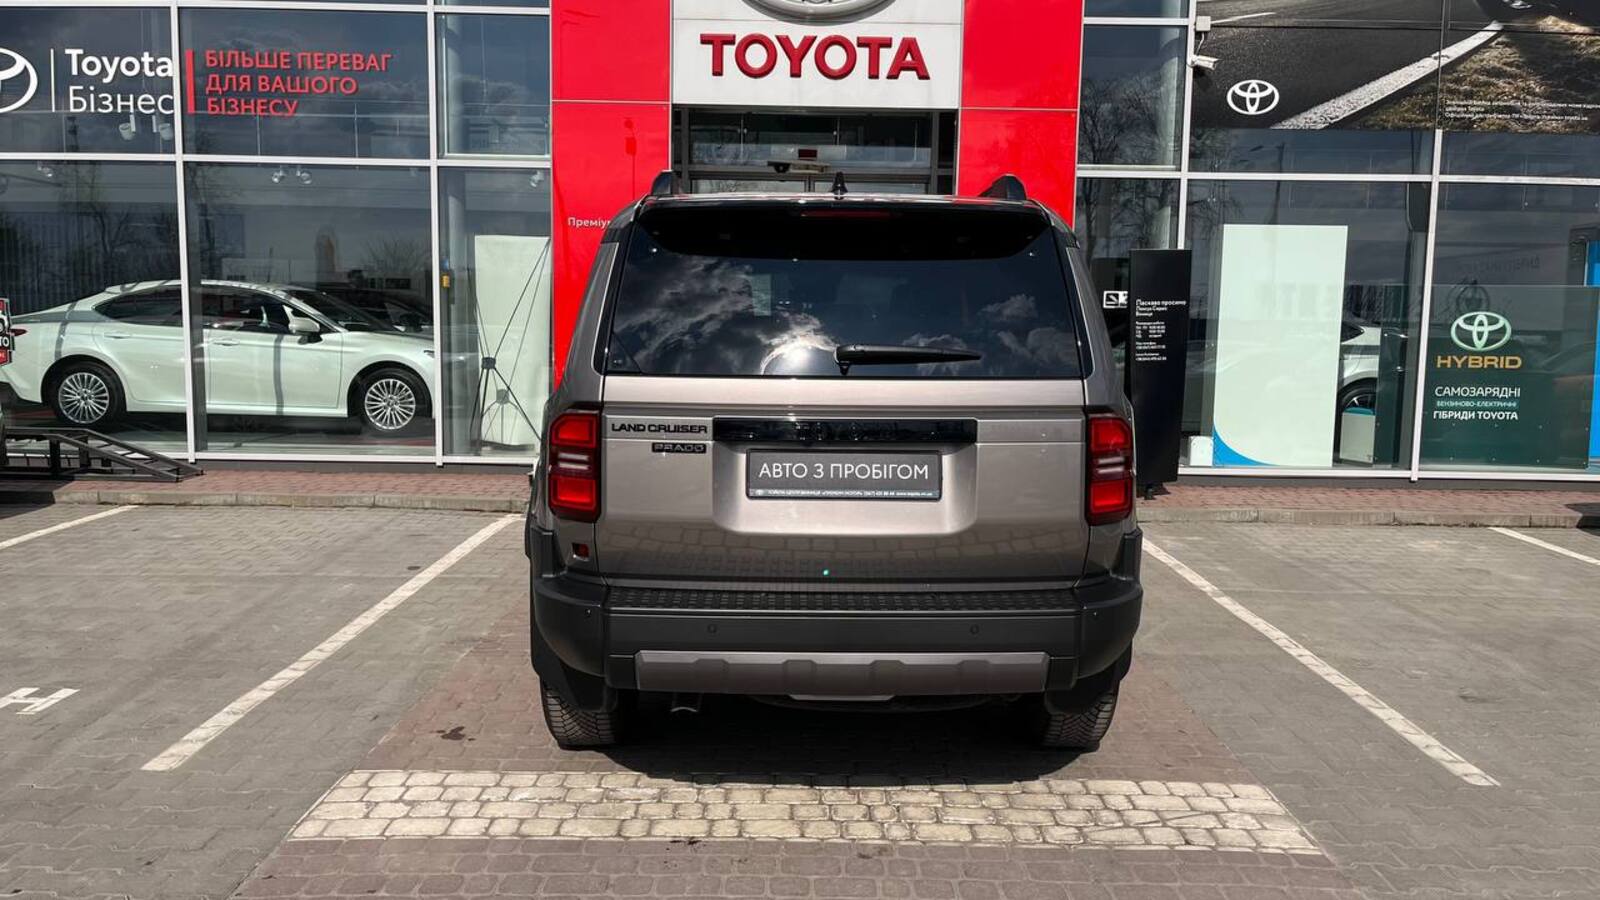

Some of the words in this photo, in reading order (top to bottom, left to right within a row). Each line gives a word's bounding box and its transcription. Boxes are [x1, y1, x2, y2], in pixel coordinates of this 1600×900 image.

[205, 50, 291, 69] БІЛЬШЕ
[297, 52, 391, 71] ПЕРЕВАГ
[700, 33, 930, 80] TOYOTA
[65, 49, 174, 83] Toyota
[205, 74, 252, 95] ДЛЯ
[257, 75, 358, 95] ВАШОГО
[69, 85, 174, 115] Бізнес
[207, 98, 298, 117] БІЗНЕСУ
[567, 216, 611, 229] Преміу
[1436, 355, 1522, 369] HYBRID
[1434, 386, 1521, 399] САМОЗАРЯДНІ
[1433, 410, 1476, 420] ГІБРИДИ
[1477, 410, 1519, 420] TOYOTA
[611, 423, 646, 433] LAND
[647, 424, 708, 434] CRUISER
[758, 462, 808, 479] АВТО
[830, 463, 929, 480] ПРОБІГОМ
